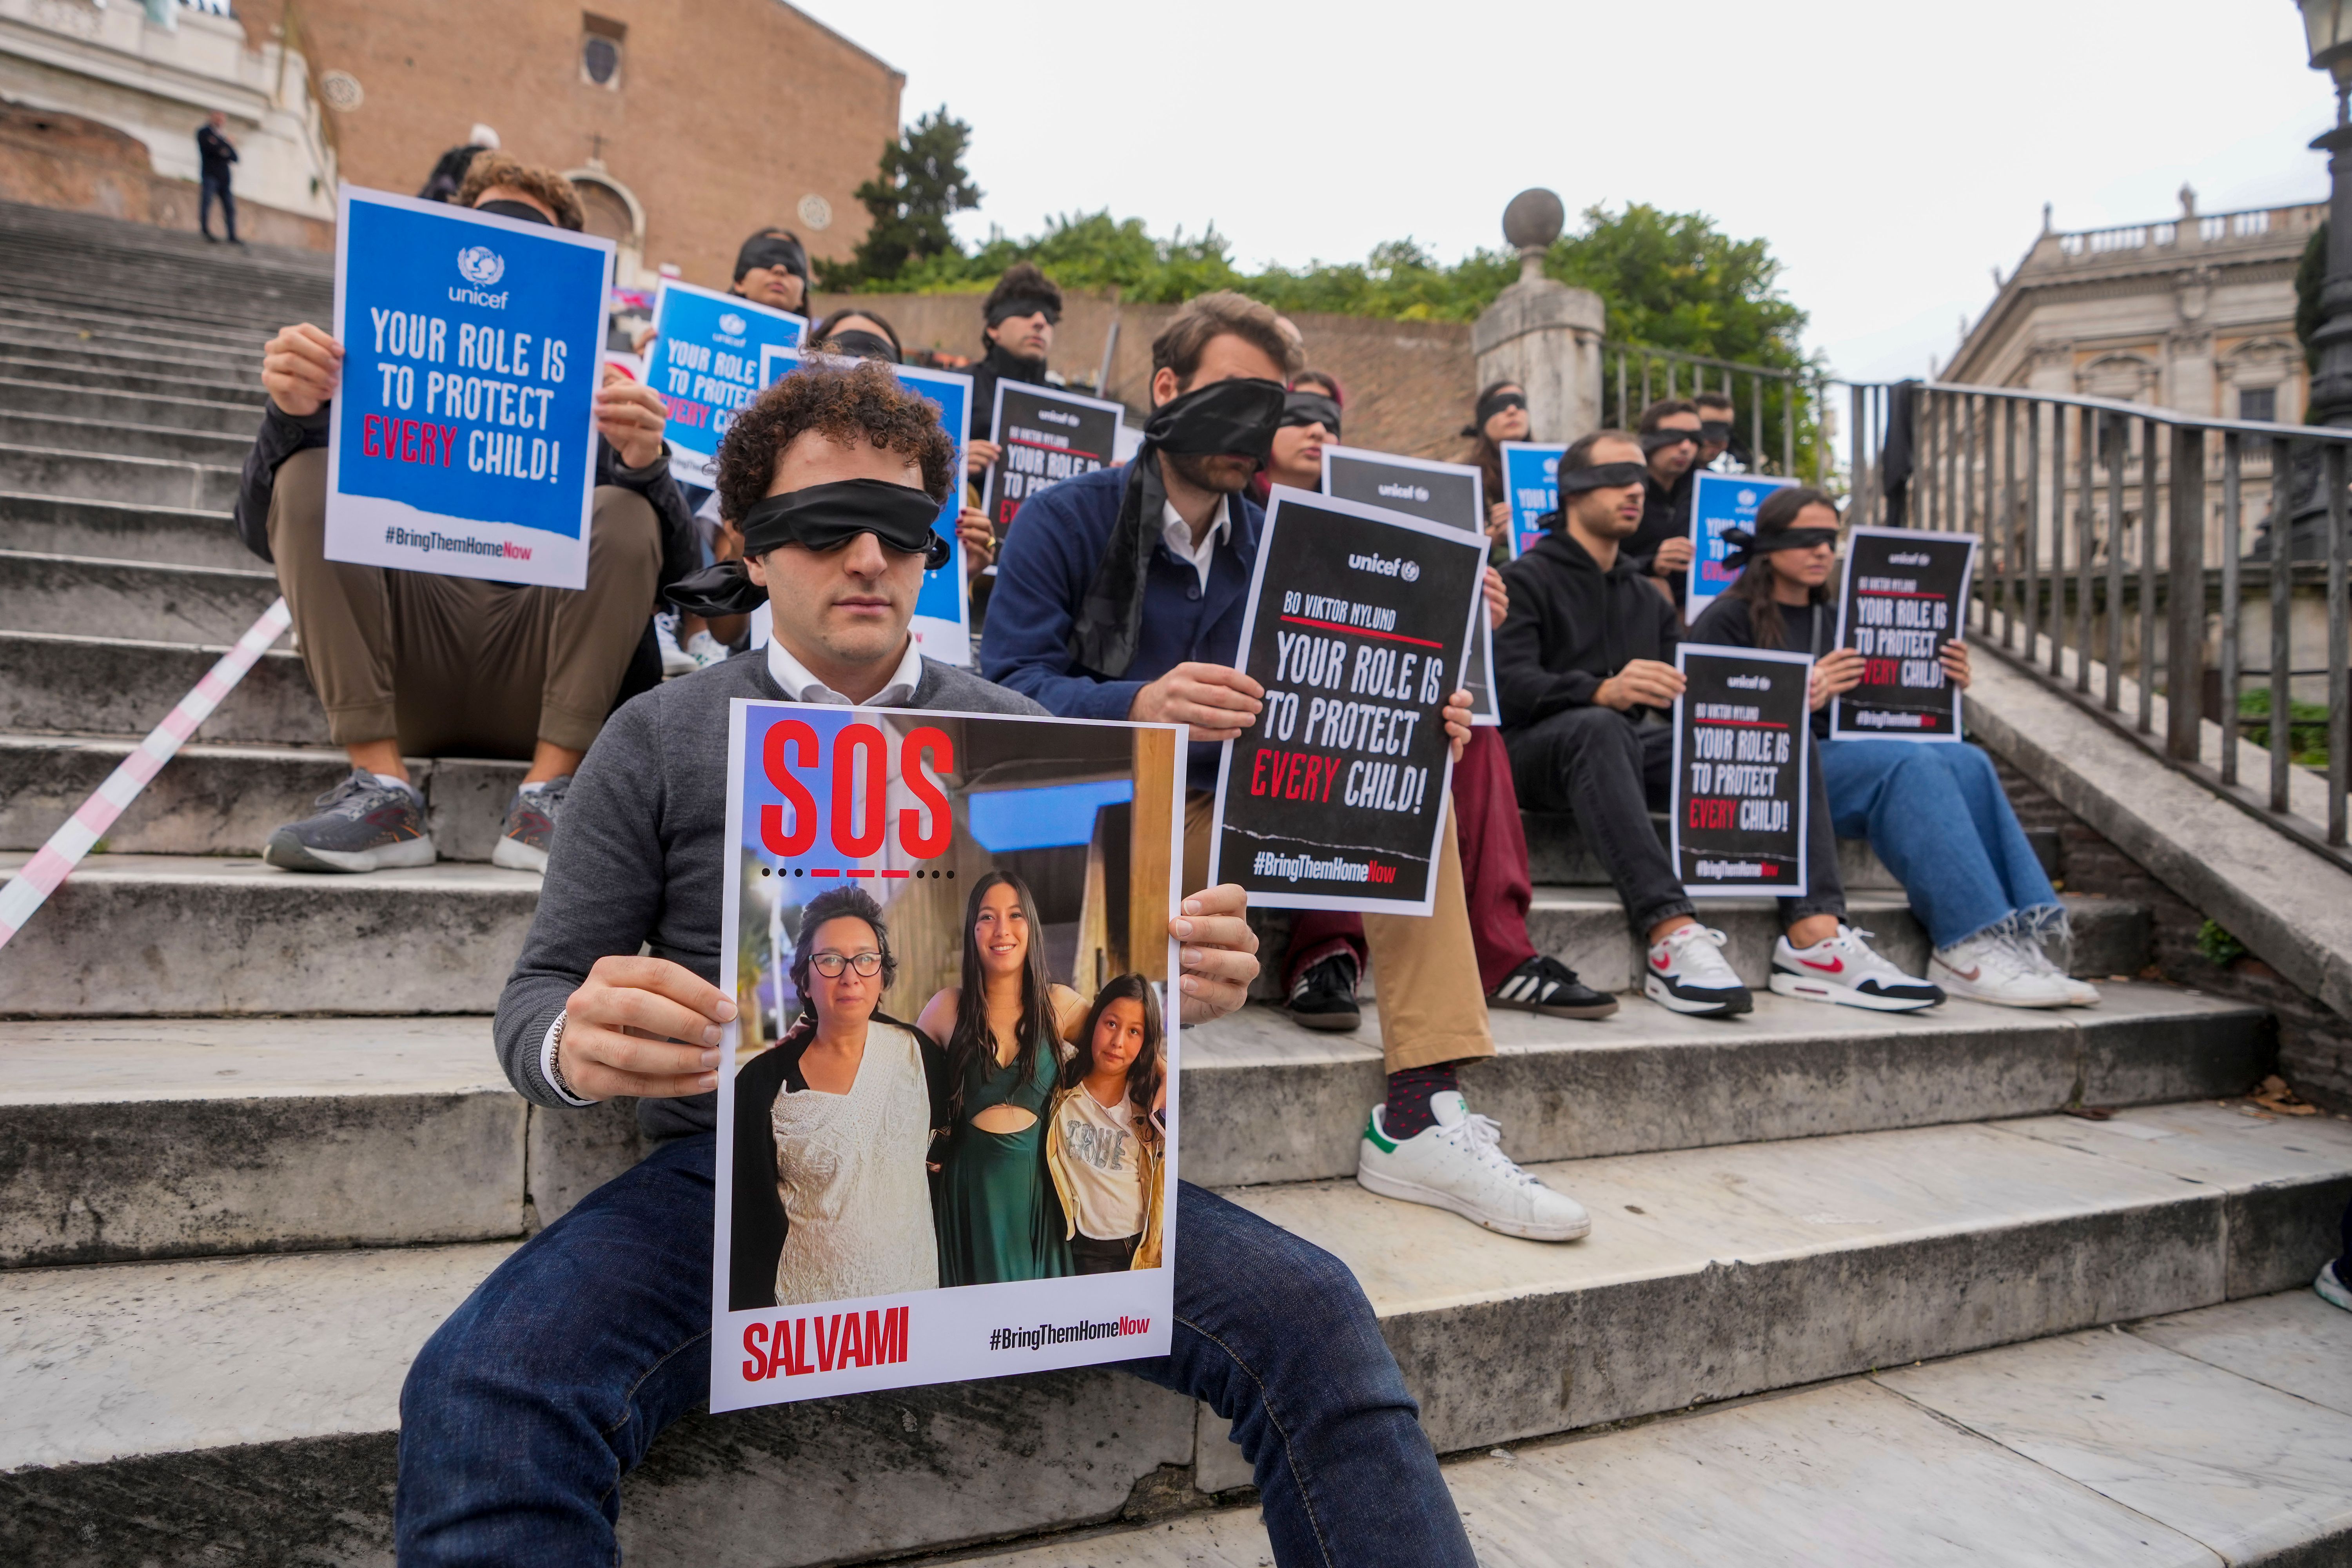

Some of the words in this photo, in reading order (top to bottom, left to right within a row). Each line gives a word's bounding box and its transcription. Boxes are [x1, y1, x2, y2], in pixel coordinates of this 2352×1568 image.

[448, 286, 509, 310] unicef
[371, 307, 447, 363] YOUR
[458, 323, 532, 376] ROLE
[541, 337, 568, 383] IS
[668, 337, 711, 372] YOUR
[713, 351, 757, 385] ROLE
[377, 362, 414, 410] TO
[426, 370, 554, 431] PROTECT
[668, 366, 690, 396] TO
[363, 413, 457, 468] EVERY
[468, 429, 560, 484] CHILD!
[1007, 443, 1045, 475] YOUR
[1003, 470, 1024, 499] TO
[1378, 482, 1414, 500] unicef
[386, 526, 532, 561] #BringThemHomeNow
[1708, 539, 1724, 561] TO
[1348, 552, 1401, 577] unicef
[1283, 590, 1301, 614] BO
[1305, 593, 1348, 623] VIKTOR
[1349, 602, 1396, 632] NYLUND
[1857, 596, 1893, 627] YOUR
[1896, 599, 1931, 628] ROLE
[1933, 601, 1947, 629] IS
[1854, 627, 1874, 655] TO
[1876, 628, 1937, 658] PROTECT
[1276, 630, 1347, 690] YOUR
[1350, 644, 1417, 701] ROLE
[1419, 655, 1443, 704] IS
[1727, 674, 1759, 690] unicef
[1860, 658, 1899, 684] VERY
[1264, 689, 1299, 741] TO
[1304, 696, 1420, 757] PROTECT
[1693, 726, 1734, 760] YOUR
[1736, 730, 1773, 762] ROLE
[1774, 731, 1790, 764] IS
[760, 719, 954, 859] SOS
[1251, 748, 1341, 803] EVERY
[1344, 759, 1428, 815] CHILD!
[1690, 762, 1711, 795] TO
[1713, 764, 1778, 797] PROTECT
[1690, 798, 1737, 829] EVERY
[1739, 799, 1788, 831] CHILD!
[1253, 851, 1396, 884] #BringThemHomeNow
[1695, 860, 1779, 880] #BringThemHomeNow
[742, 1306, 909, 1382] SALVAMI
[989, 1316, 1150, 1350] #BringThemHomeNow
